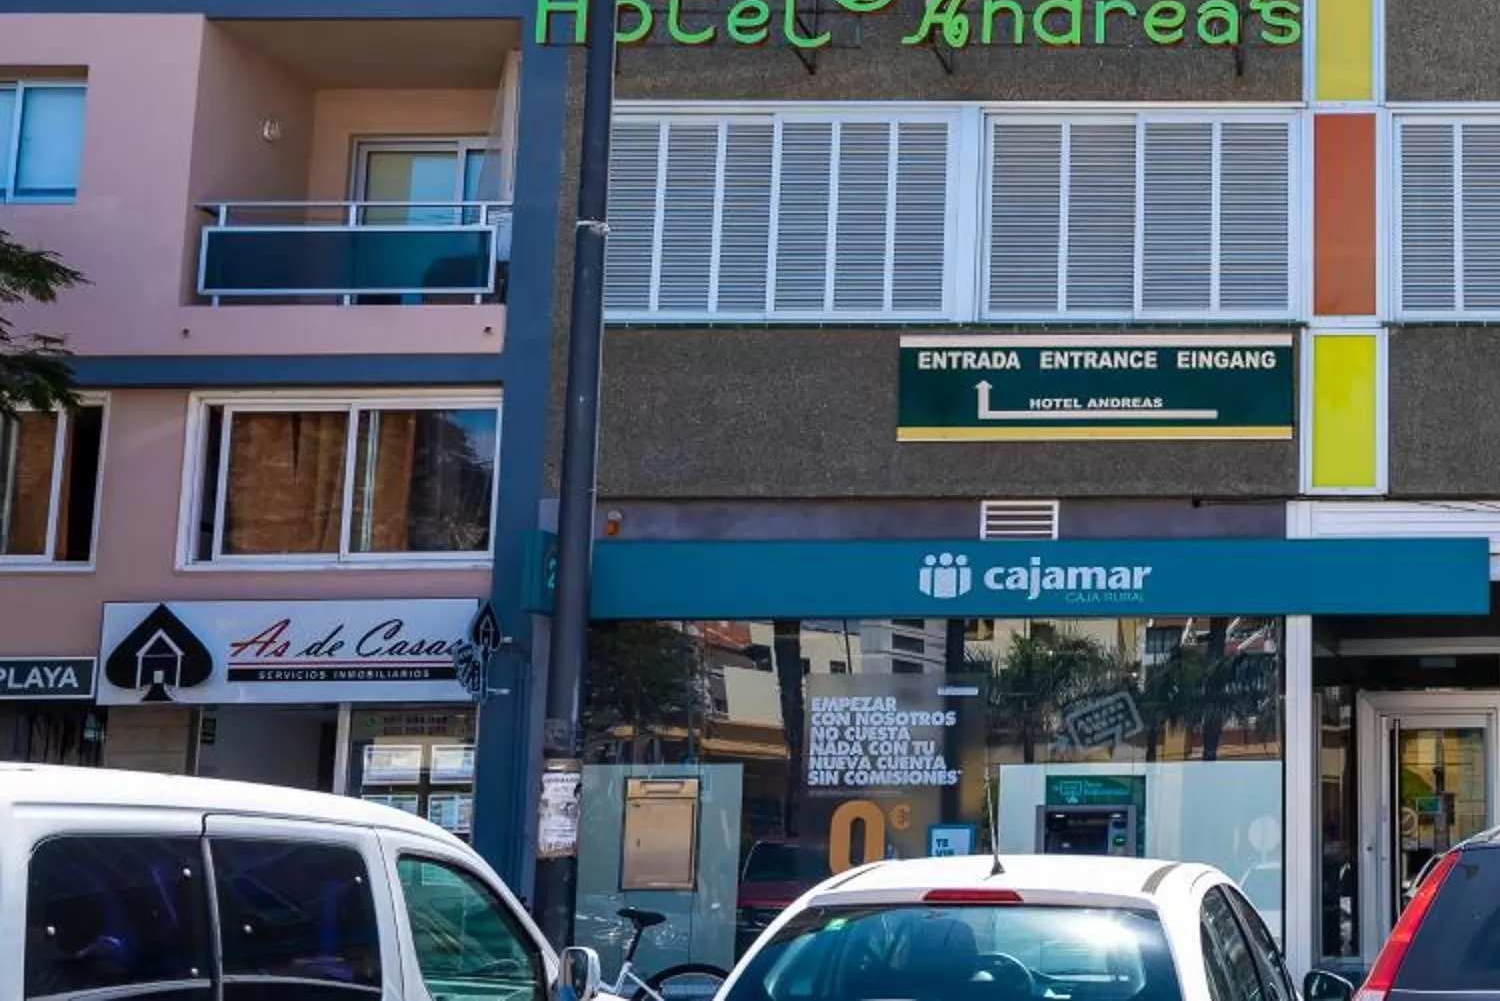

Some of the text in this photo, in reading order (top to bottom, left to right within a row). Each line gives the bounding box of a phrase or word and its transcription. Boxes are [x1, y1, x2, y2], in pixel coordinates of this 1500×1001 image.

[917, 350, 1277, 370] ENTRADA ENTRANCE EINGANG
[1029, 397, 1163, 409] HOTEL ANDREAS
[983, 556, 1152, 600] cajamar
[230, 618, 291, 658] As
[295, 624, 346, 657] de
[258, 669, 430, 680] SERVICIOS INMOBILIARIOS
[811, 696, 897, 712] EMPEZAR
[811, 711, 956, 726] CON NOSOTROS
[811, 726, 911, 742] NO CUESTA
[810, 740, 935, 756] NADA CON TU
[809, 755, 947, 770] NUEVA CUENTA
[807, 771, 839, 786] SIN
